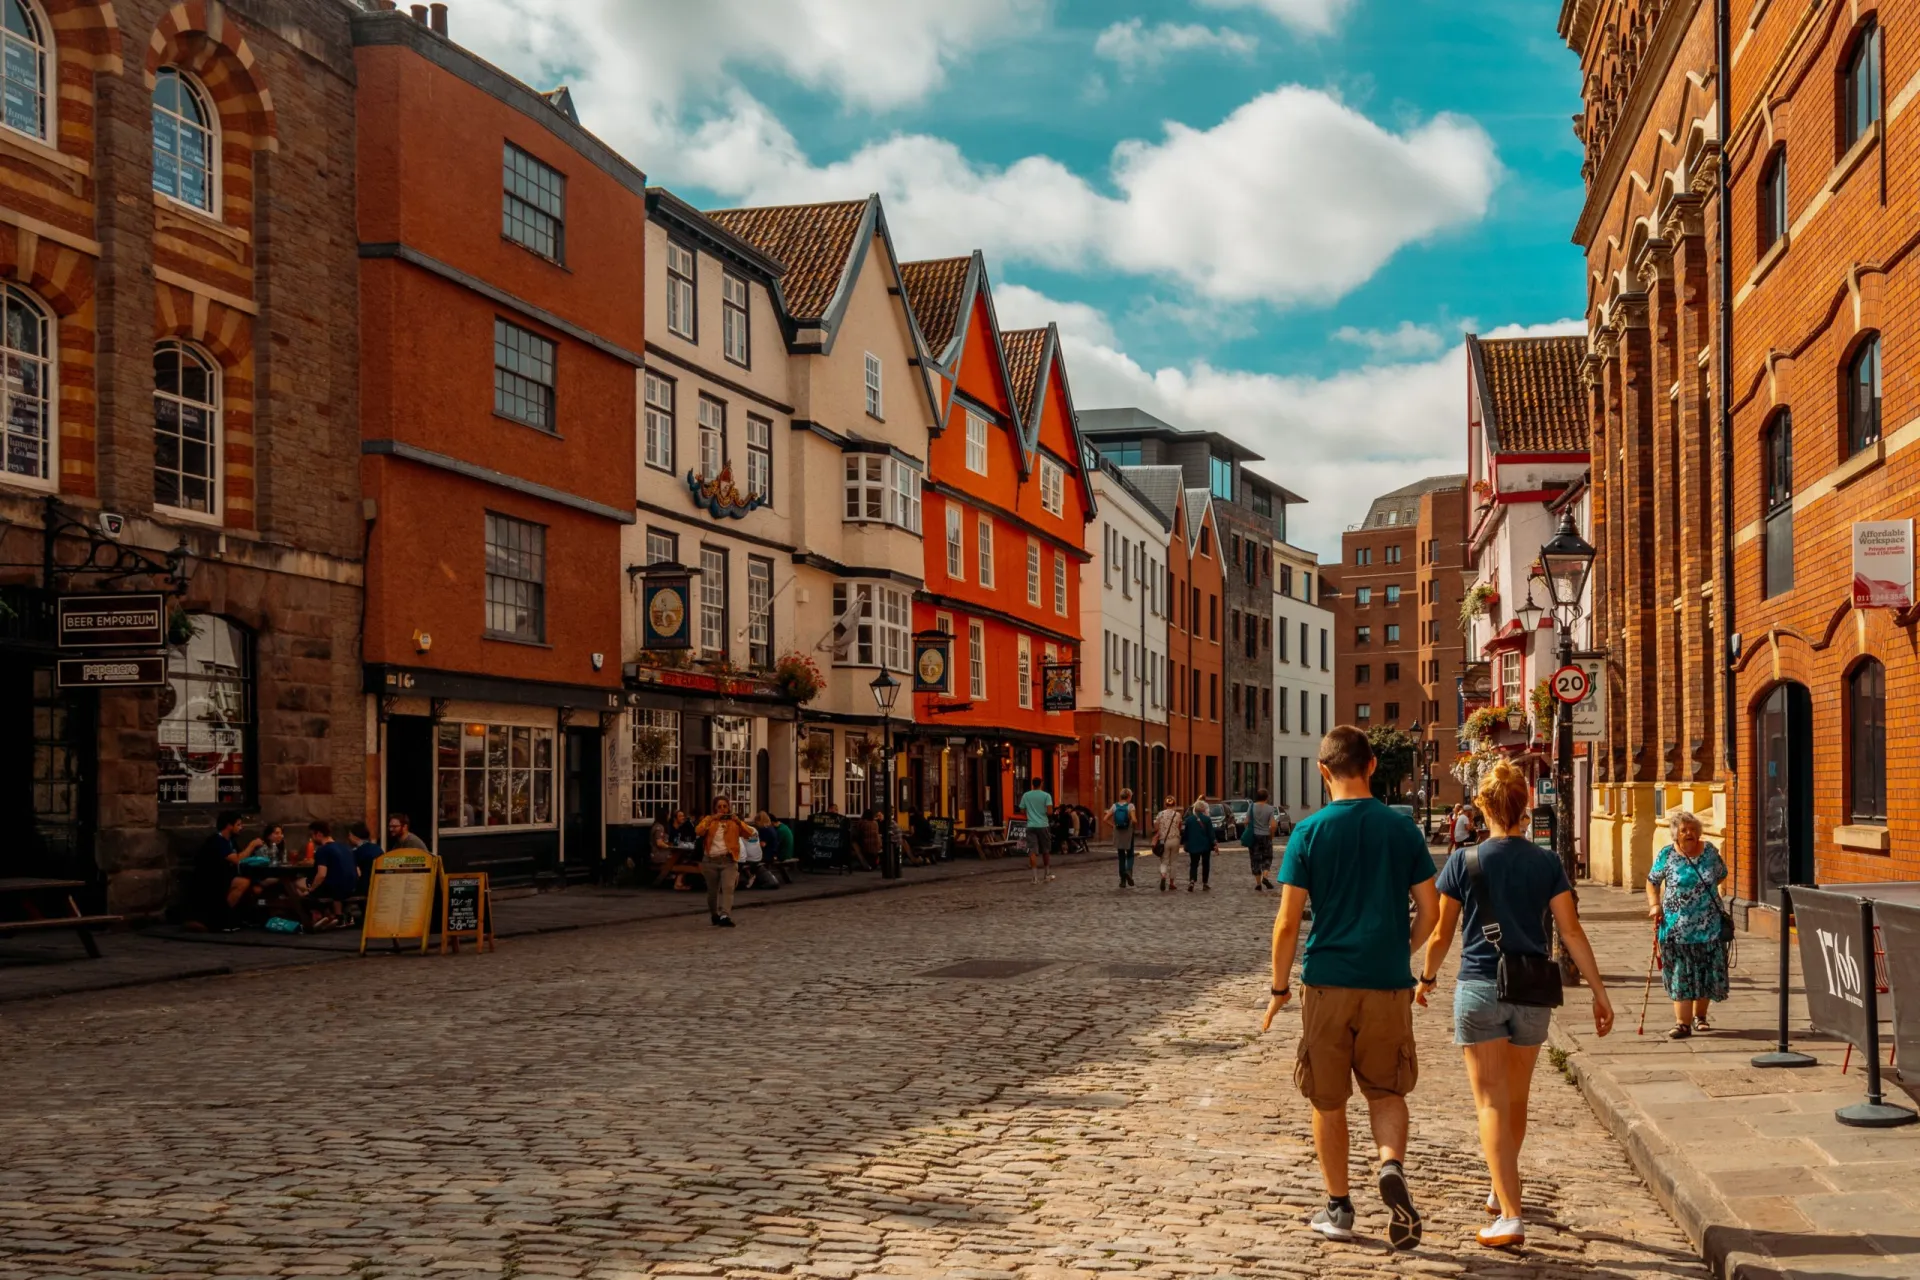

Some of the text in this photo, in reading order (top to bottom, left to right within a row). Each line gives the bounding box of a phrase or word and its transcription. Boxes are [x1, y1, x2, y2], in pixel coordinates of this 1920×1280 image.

[1860, 529, 1905, 538] Affordable
[1859, 537, 1905, 546] Workspace
[67, 614, 154, 627] BEER EMPORIUM
[83, 663, 140, 681] pepenero
[1558, 676, 1583, 692] 20
[608, 693, 618, 707] 16
[1543, 781, 1552, 794] P
[1816, 928, 1860, 999] 1766
